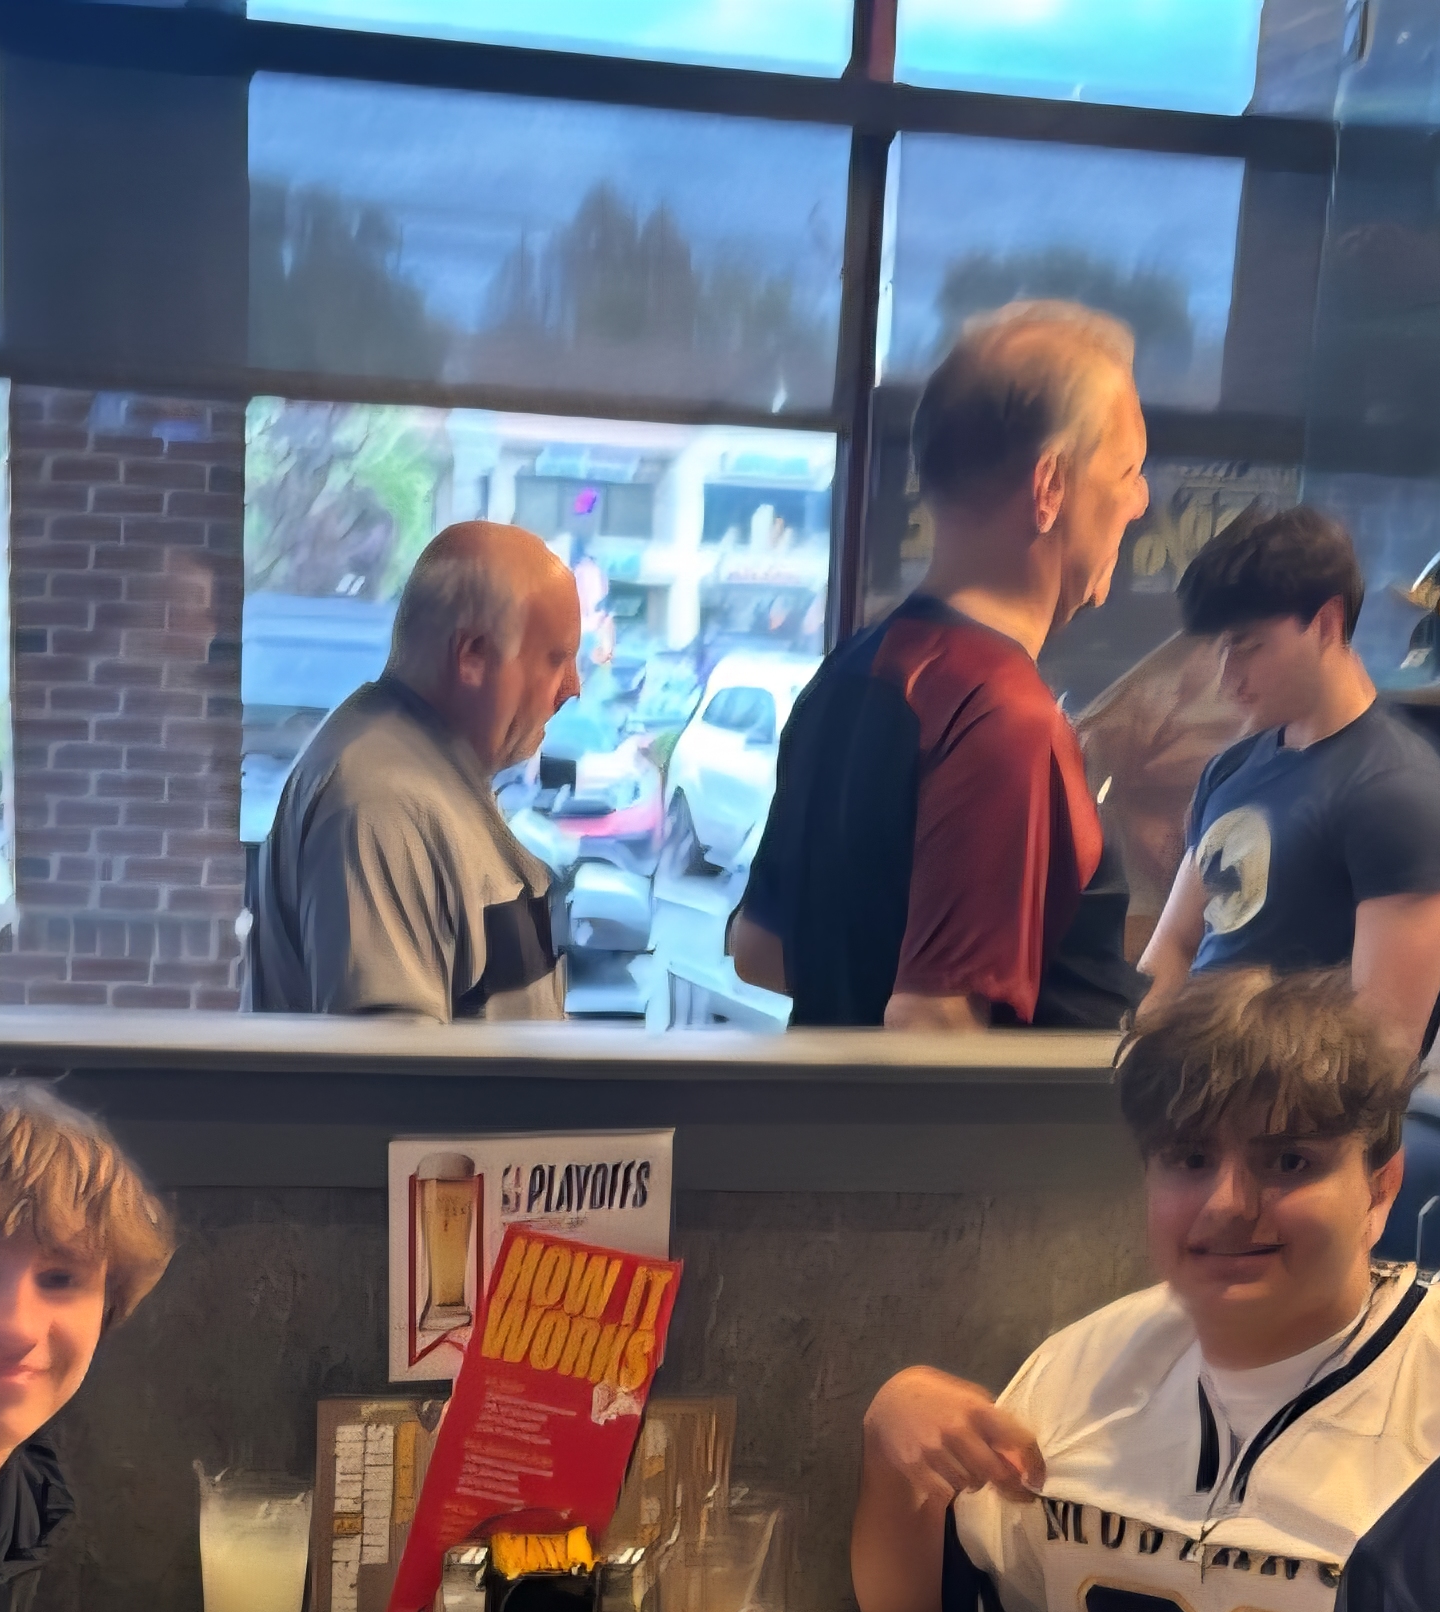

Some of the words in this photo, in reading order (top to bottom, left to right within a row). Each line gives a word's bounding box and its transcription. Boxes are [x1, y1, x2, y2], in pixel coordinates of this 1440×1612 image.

[527, 1160, 651, 1213] PLAYOFFS
[490, 1235, 623, 1318] HOW
[621, 1265, 674, 1330] IT
[481, 1299, 656, 1390] WORKS
